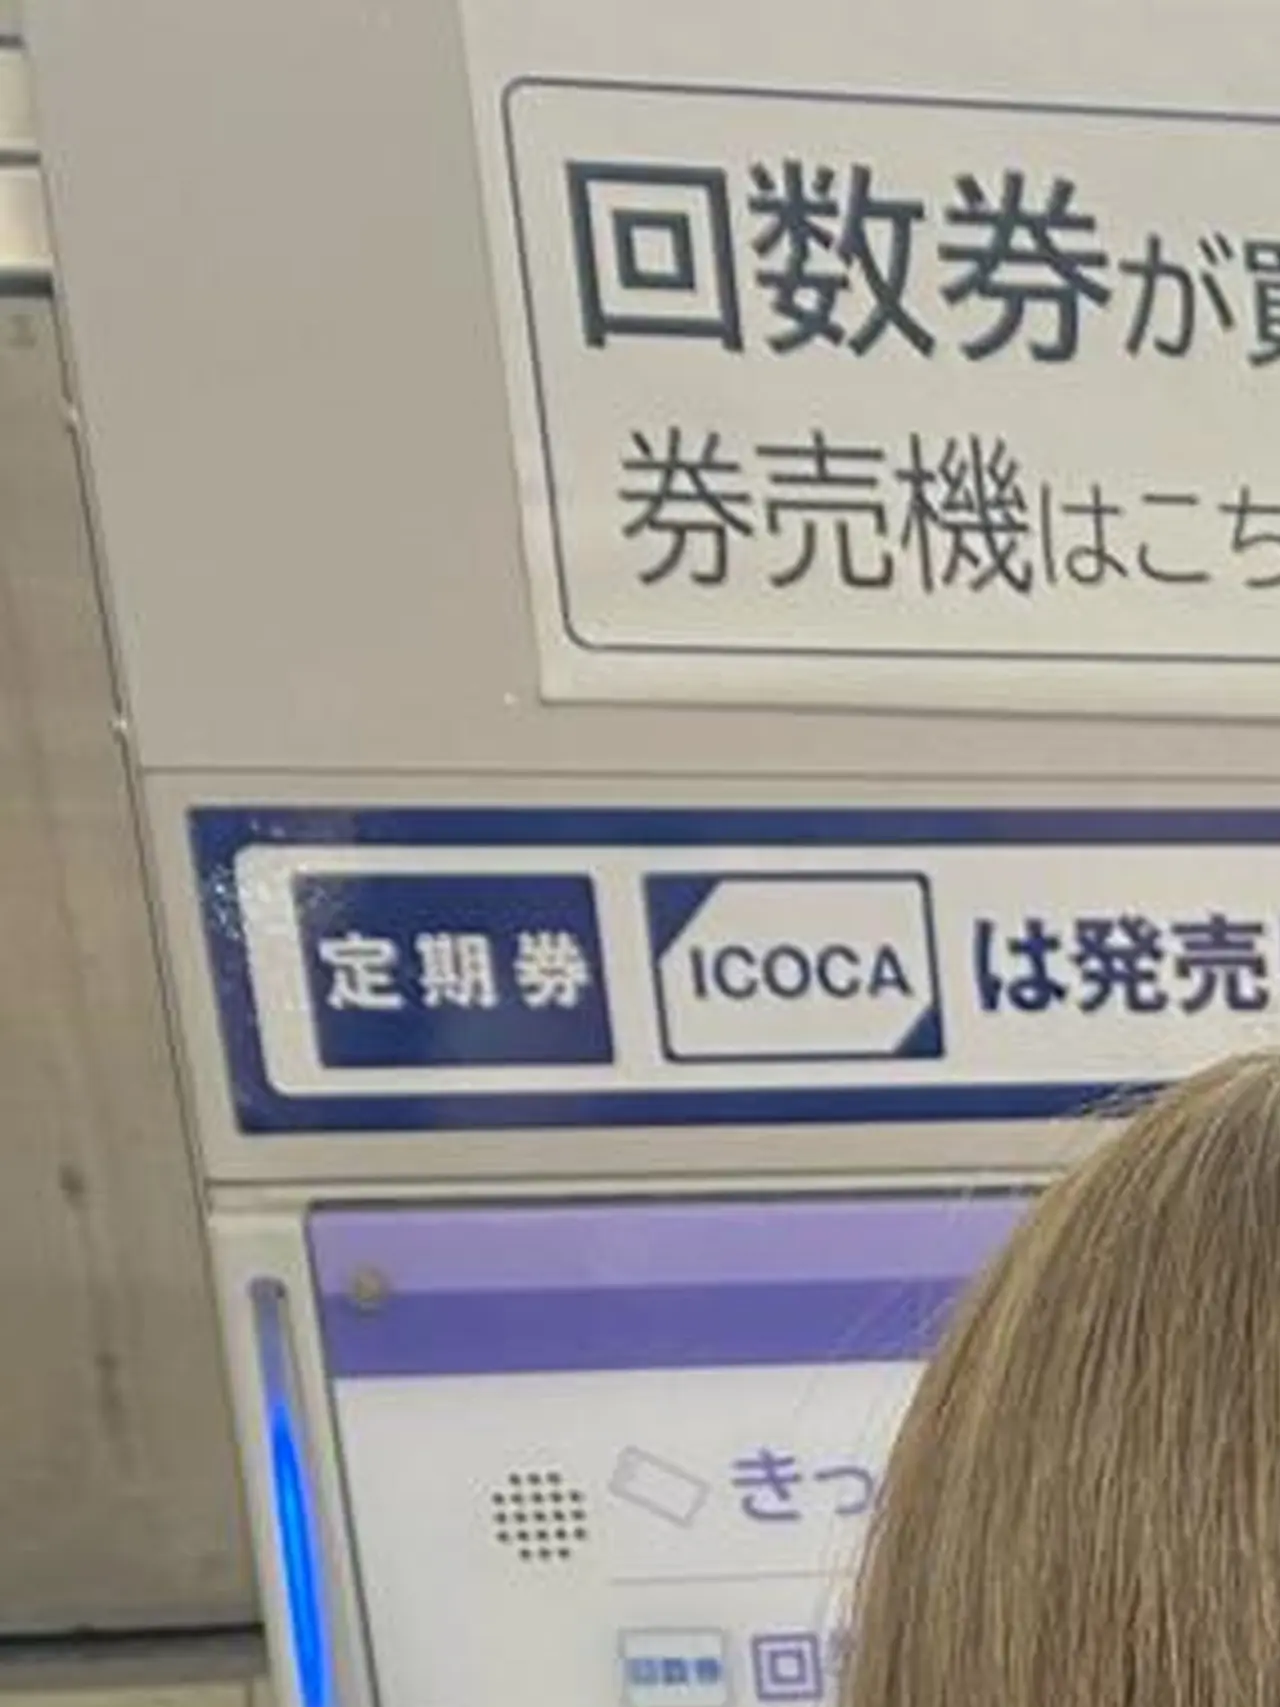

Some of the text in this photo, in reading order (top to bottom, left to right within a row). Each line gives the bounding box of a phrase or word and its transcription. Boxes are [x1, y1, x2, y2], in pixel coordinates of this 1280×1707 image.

[318, 930, 595, 1011] 定期券
[689, 943, 914, 1001] ICOCA
